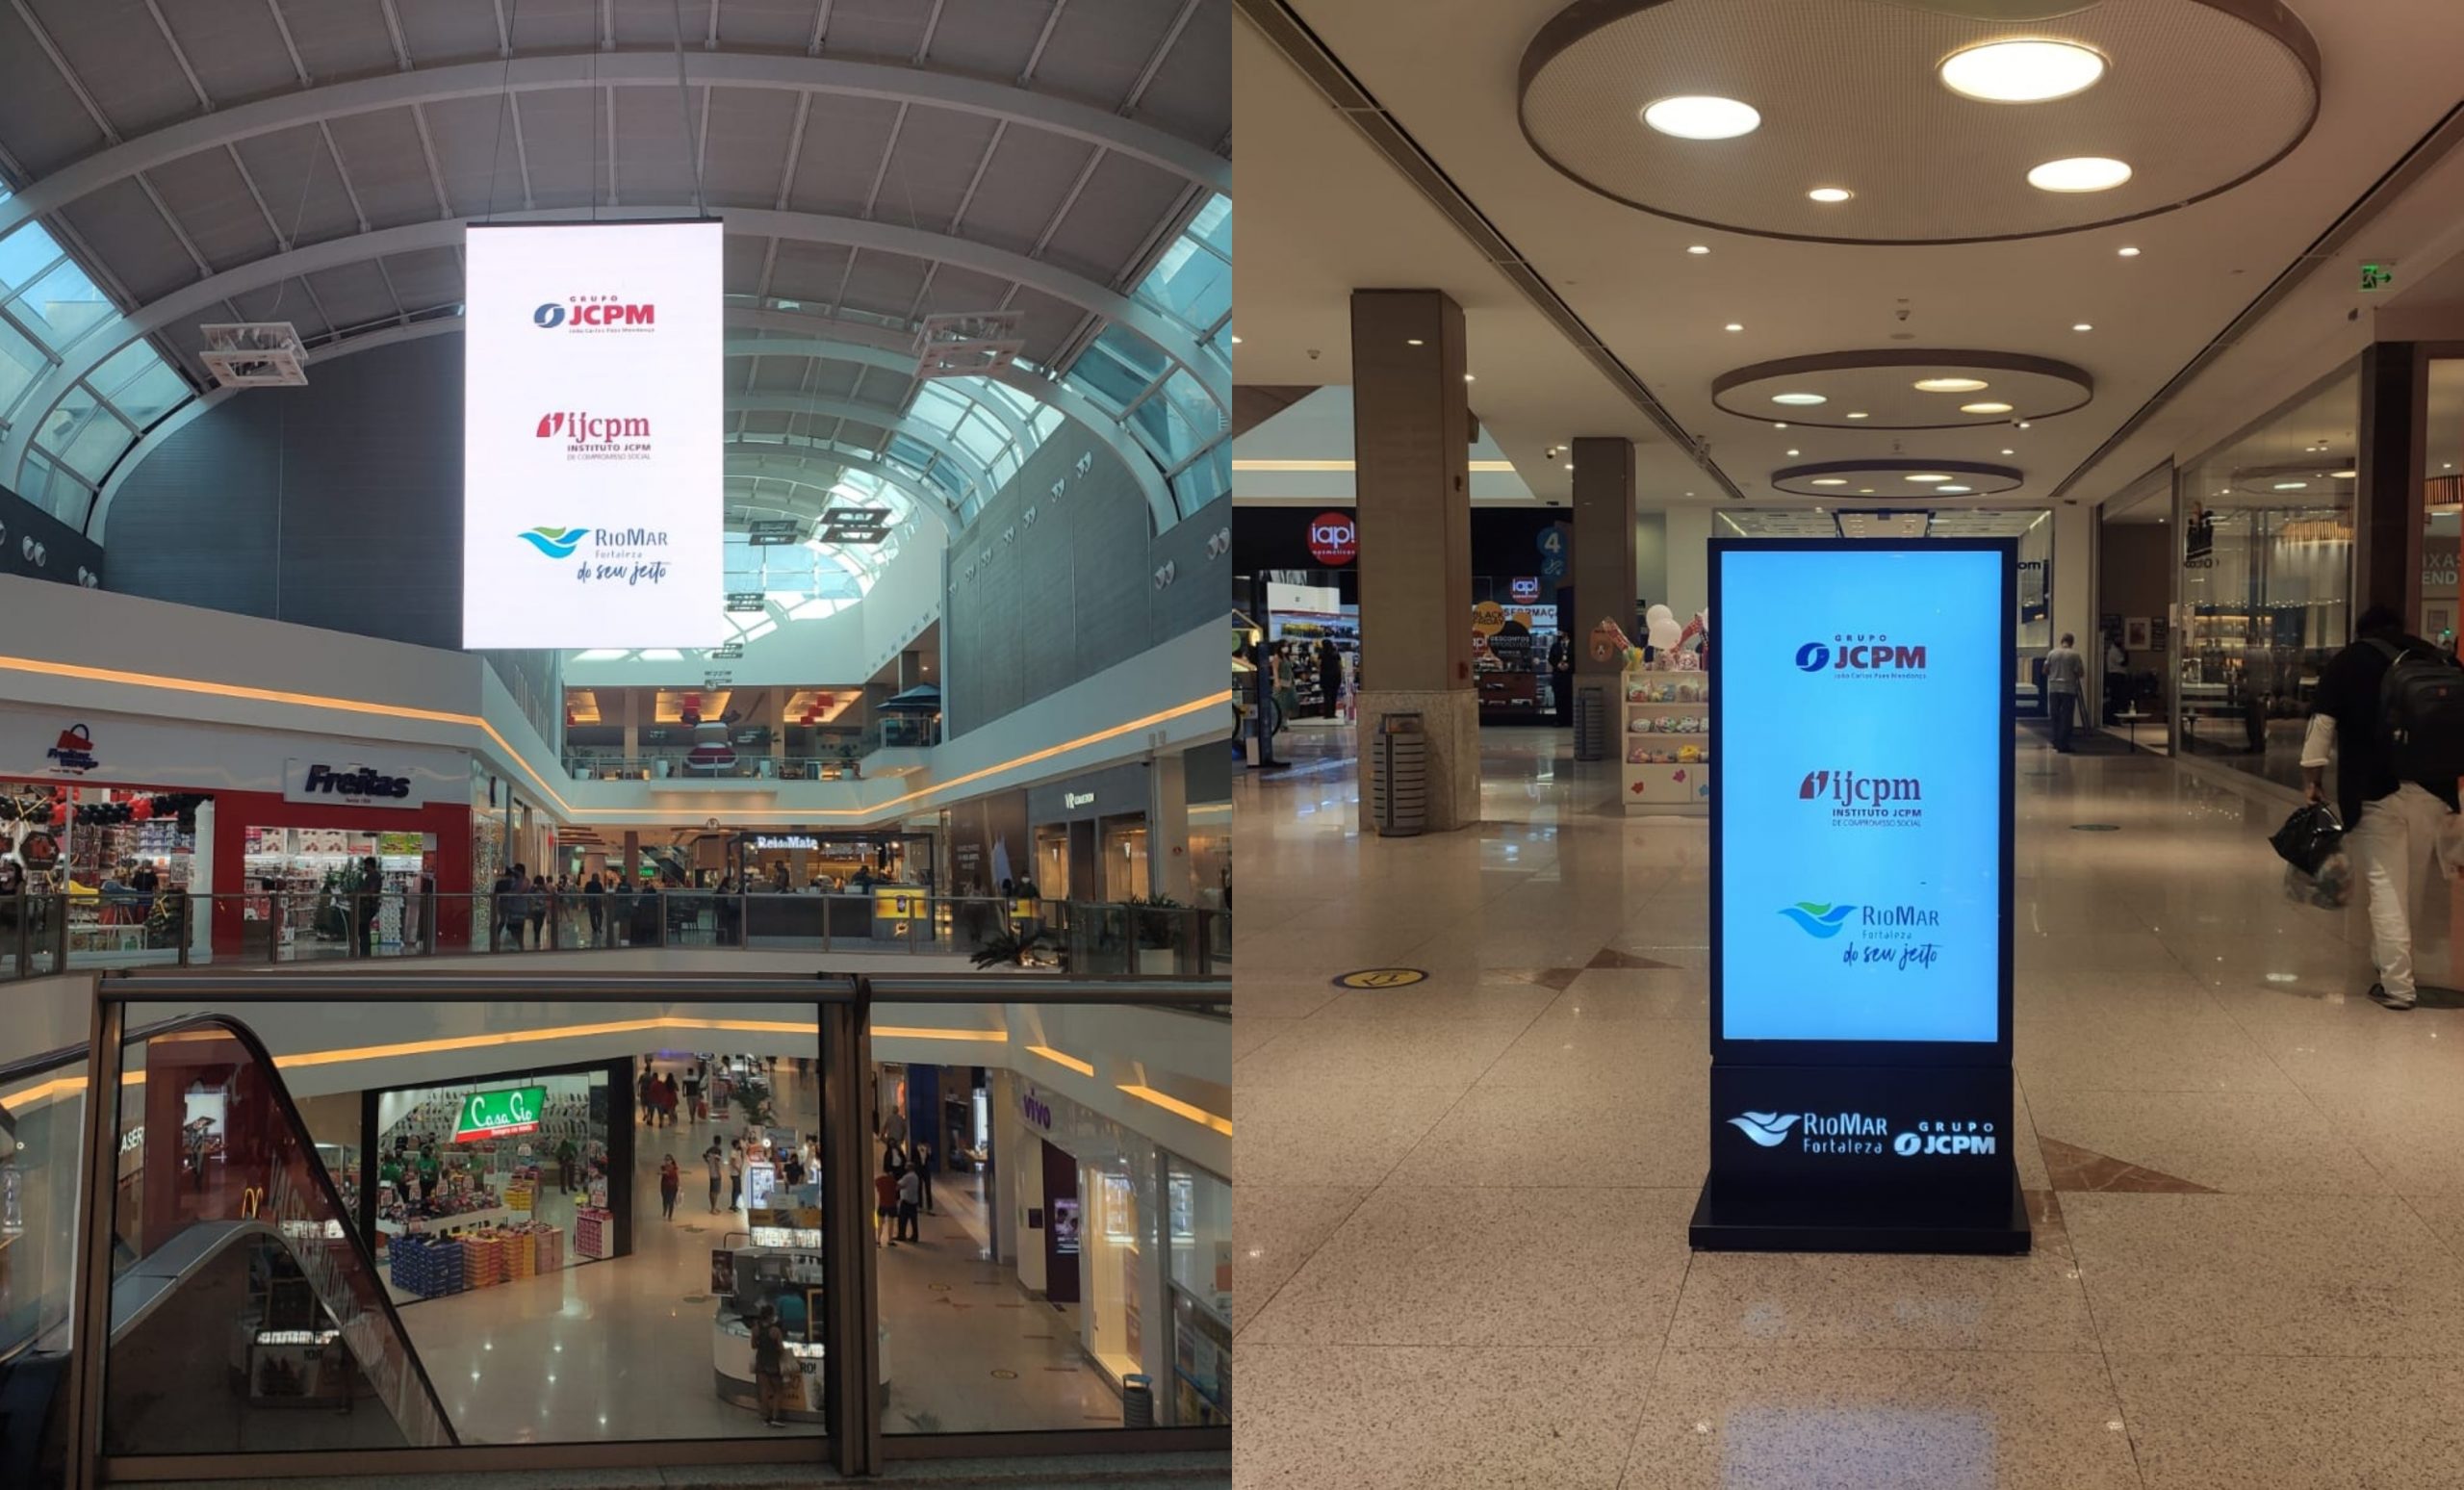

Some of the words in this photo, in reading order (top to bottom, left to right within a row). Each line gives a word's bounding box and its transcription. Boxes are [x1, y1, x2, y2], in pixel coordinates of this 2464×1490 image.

[569, 304, 654, 325] JCPM
[568, 412, 651, 443] ijcpm
[1544, 532, 1560, 552] 4
[578, 560, 591, 583] do
[596, 564, 627, 579] seu
[629, 561, 672, 586] jeito
[1835, 646, 1927, 669] JCPM
[305, 764, 411, 798] Freitas
[1833, 771, 1922, 807] ijcpm
[1833, 809, 1888, 817] INSTITUTO
[1892, 809, 1922, 817] JCPM
[1862, 931, 1912, 939] Fortaleza
[1843, 941, 1859, 966] do
[1863, 945, 1897, 963] seu
[1898, 943, 1943, 971] jeito
[472, 1096, 511, 1127] Casa
[1023, 1088, 1051, 1131] vivo
[1918, 1121, 1994, 1133] GRUPO
[120, 1126, 144, 1155] ASER
[1803, 1138, 1883, 1154] Fortaleza
[1923, 1136, 1995, 1154] JCPM
